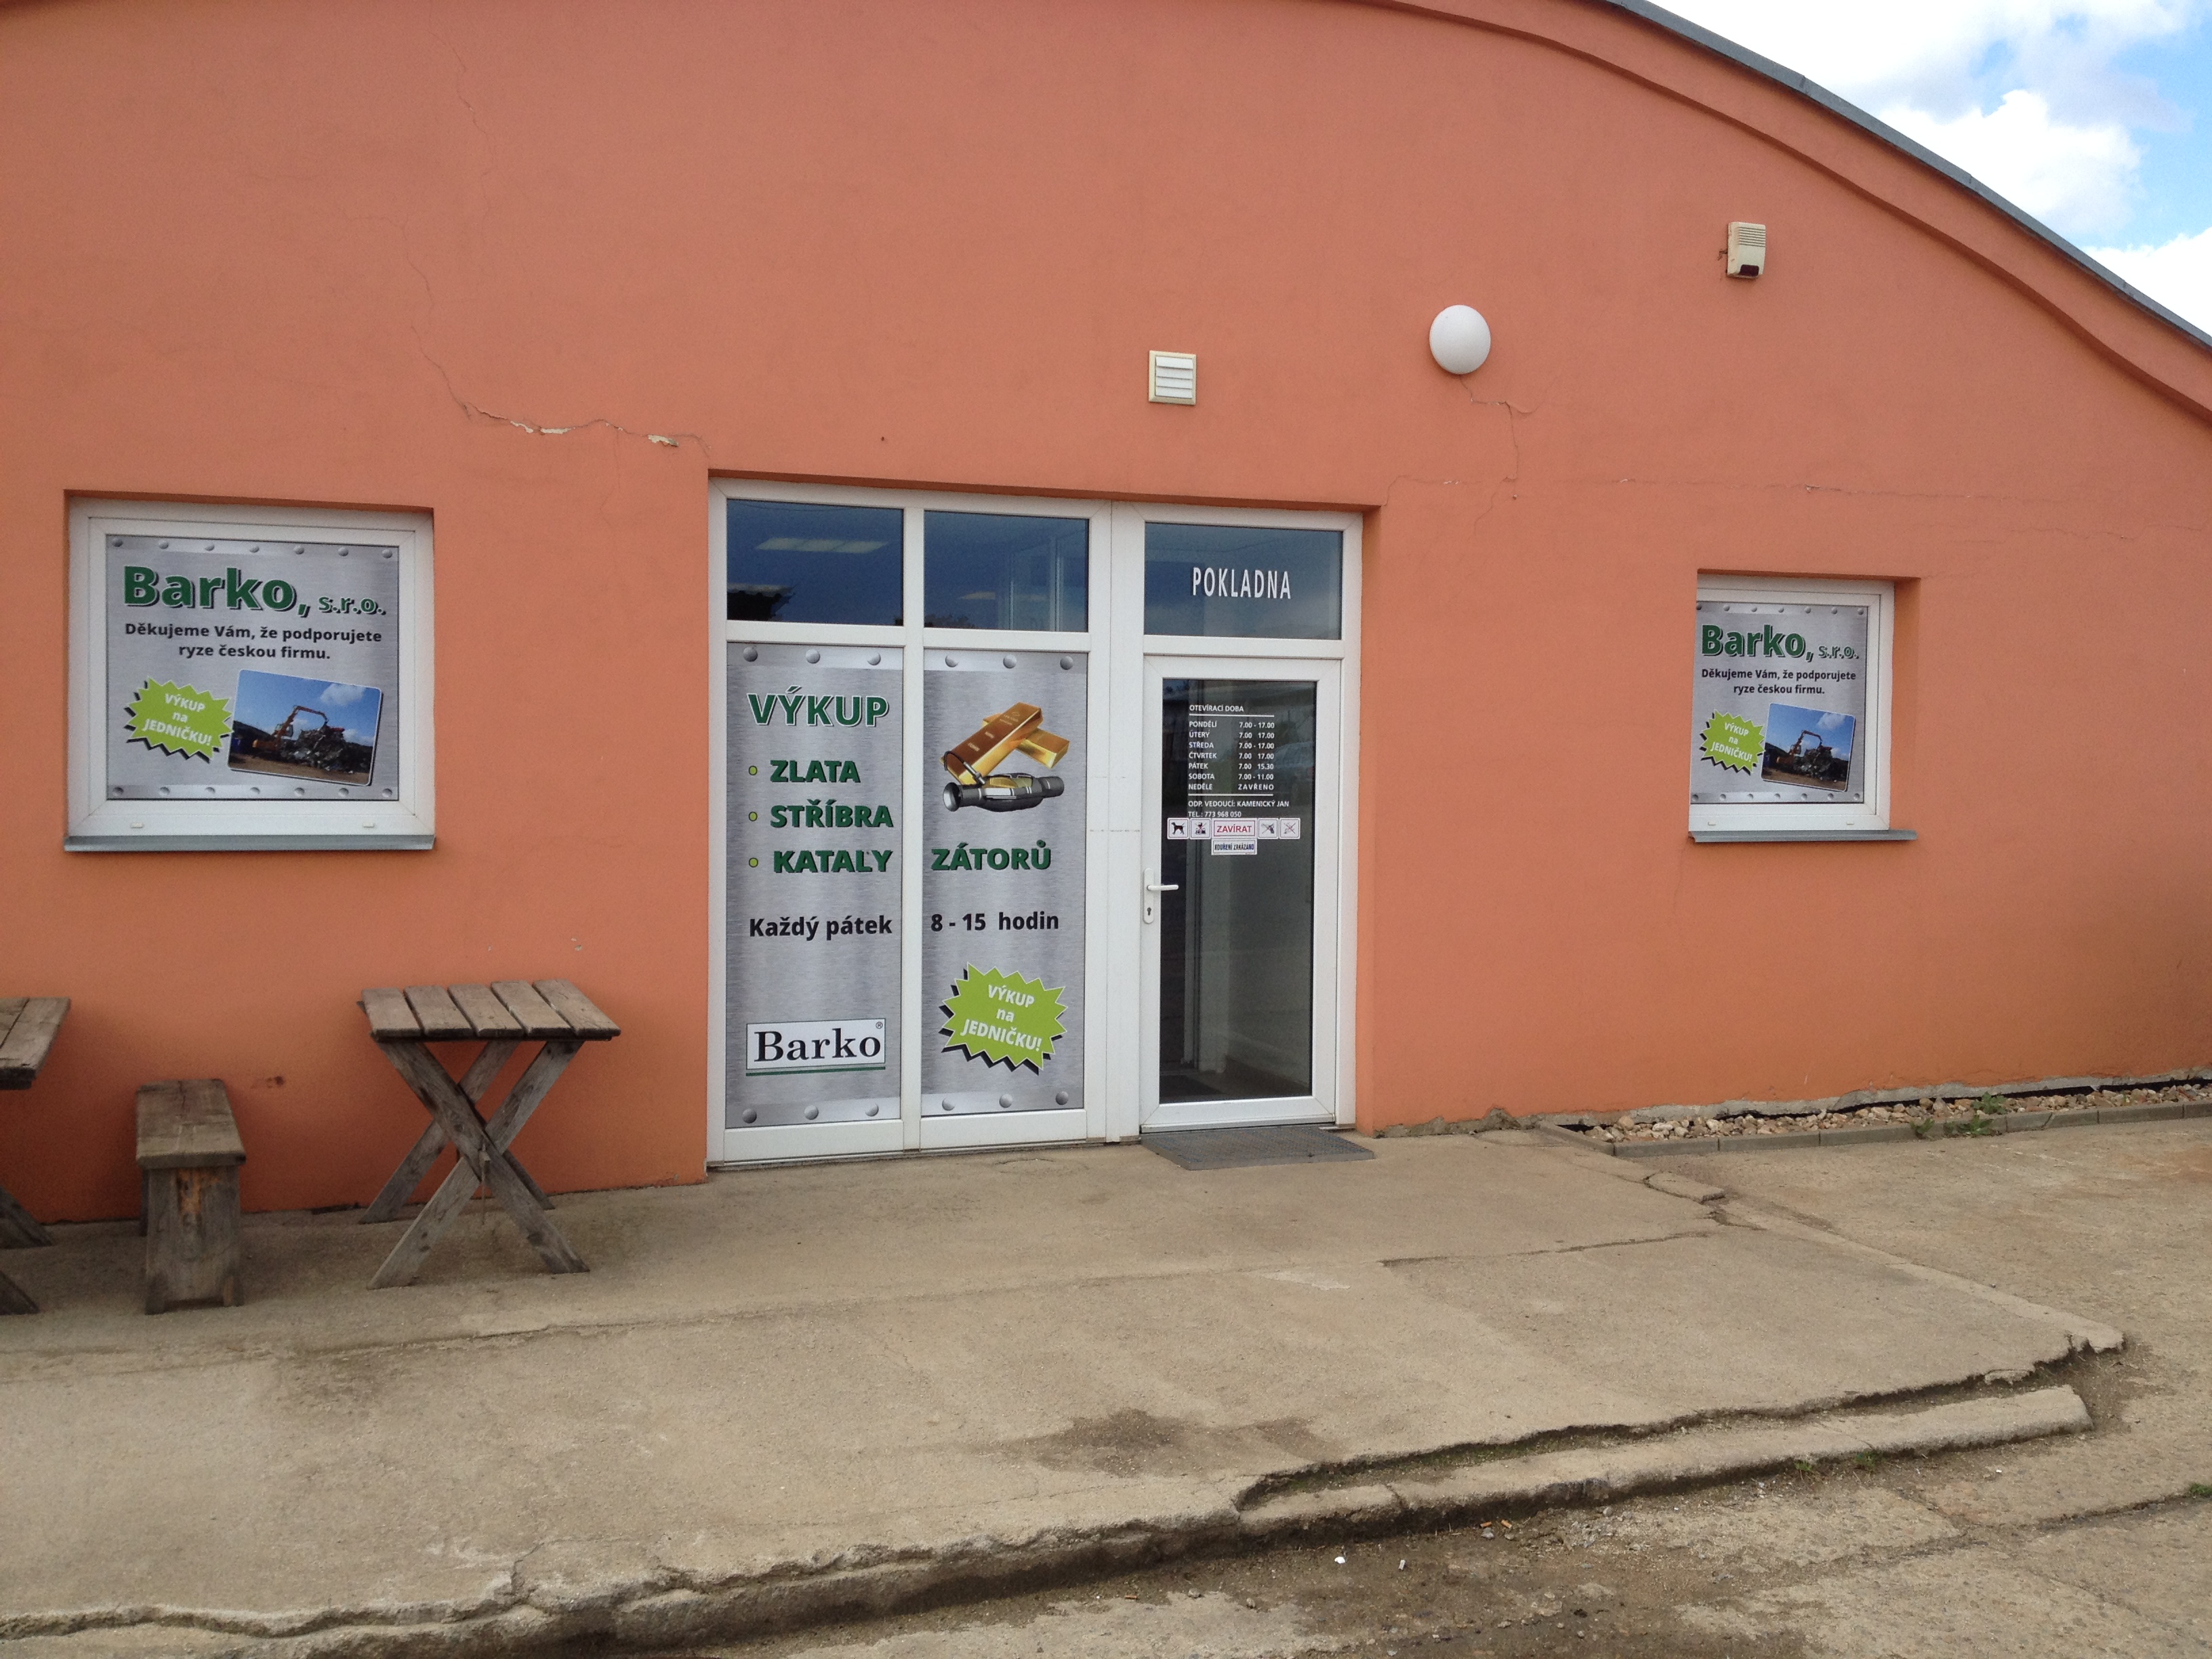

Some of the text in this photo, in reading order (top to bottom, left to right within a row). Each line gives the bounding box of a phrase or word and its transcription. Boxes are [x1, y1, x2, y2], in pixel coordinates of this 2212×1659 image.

[123, 565, 387, 617] Barko, s.r.o.
[1193, 567, 1291, 599] POKLADNA
[125, 622, 382, 644] Děkujeme Vám, že podporujete
[1701, 624, 1859, 662] Barko, s.r.o.
[178, 644, 331, 659] ryze českou firmu.
[1702, 668, 1856, 682] Děkujeme Vám, že podporujete
[1734, 684, 1825, 695] ryze českou firmu.
[164, 693, 206, 713] VÝKUP
[747, 686, 890, 726] VÝKUP
[172, 711, 188, 723] na
[142, 718, 213, 745] JEDNIČKU!
[1189, 730, 1210, 738] ÚTERÝ
[1724, 722, 1749, 737] VÝKUP
[1729, 735, 1738, 745] na
[1711, 741, 1753, 762] JEDNIČKU!
[770, 760, 861, 783] ZLATA
[770, 798, 893, 828] STŘÍBRA
[1217, 824, 1252, 833] ZAVÍRAT
[773, 840, 1051, 873] KATALY ZÁTORŮ
[750, 916, 819, 941] Každý
[826, 915, 893, 941] pátek
[930, 914, 943, 931] 8
[962, 913, 986, 930] 15
[998, 912, 1059, 931] hodin
[988, 984, 1035, 1008] VÝKUP
[996, 1007, 1015, 1023] na
[960, 1019, 1042, 1052] JEDNIČKU!
